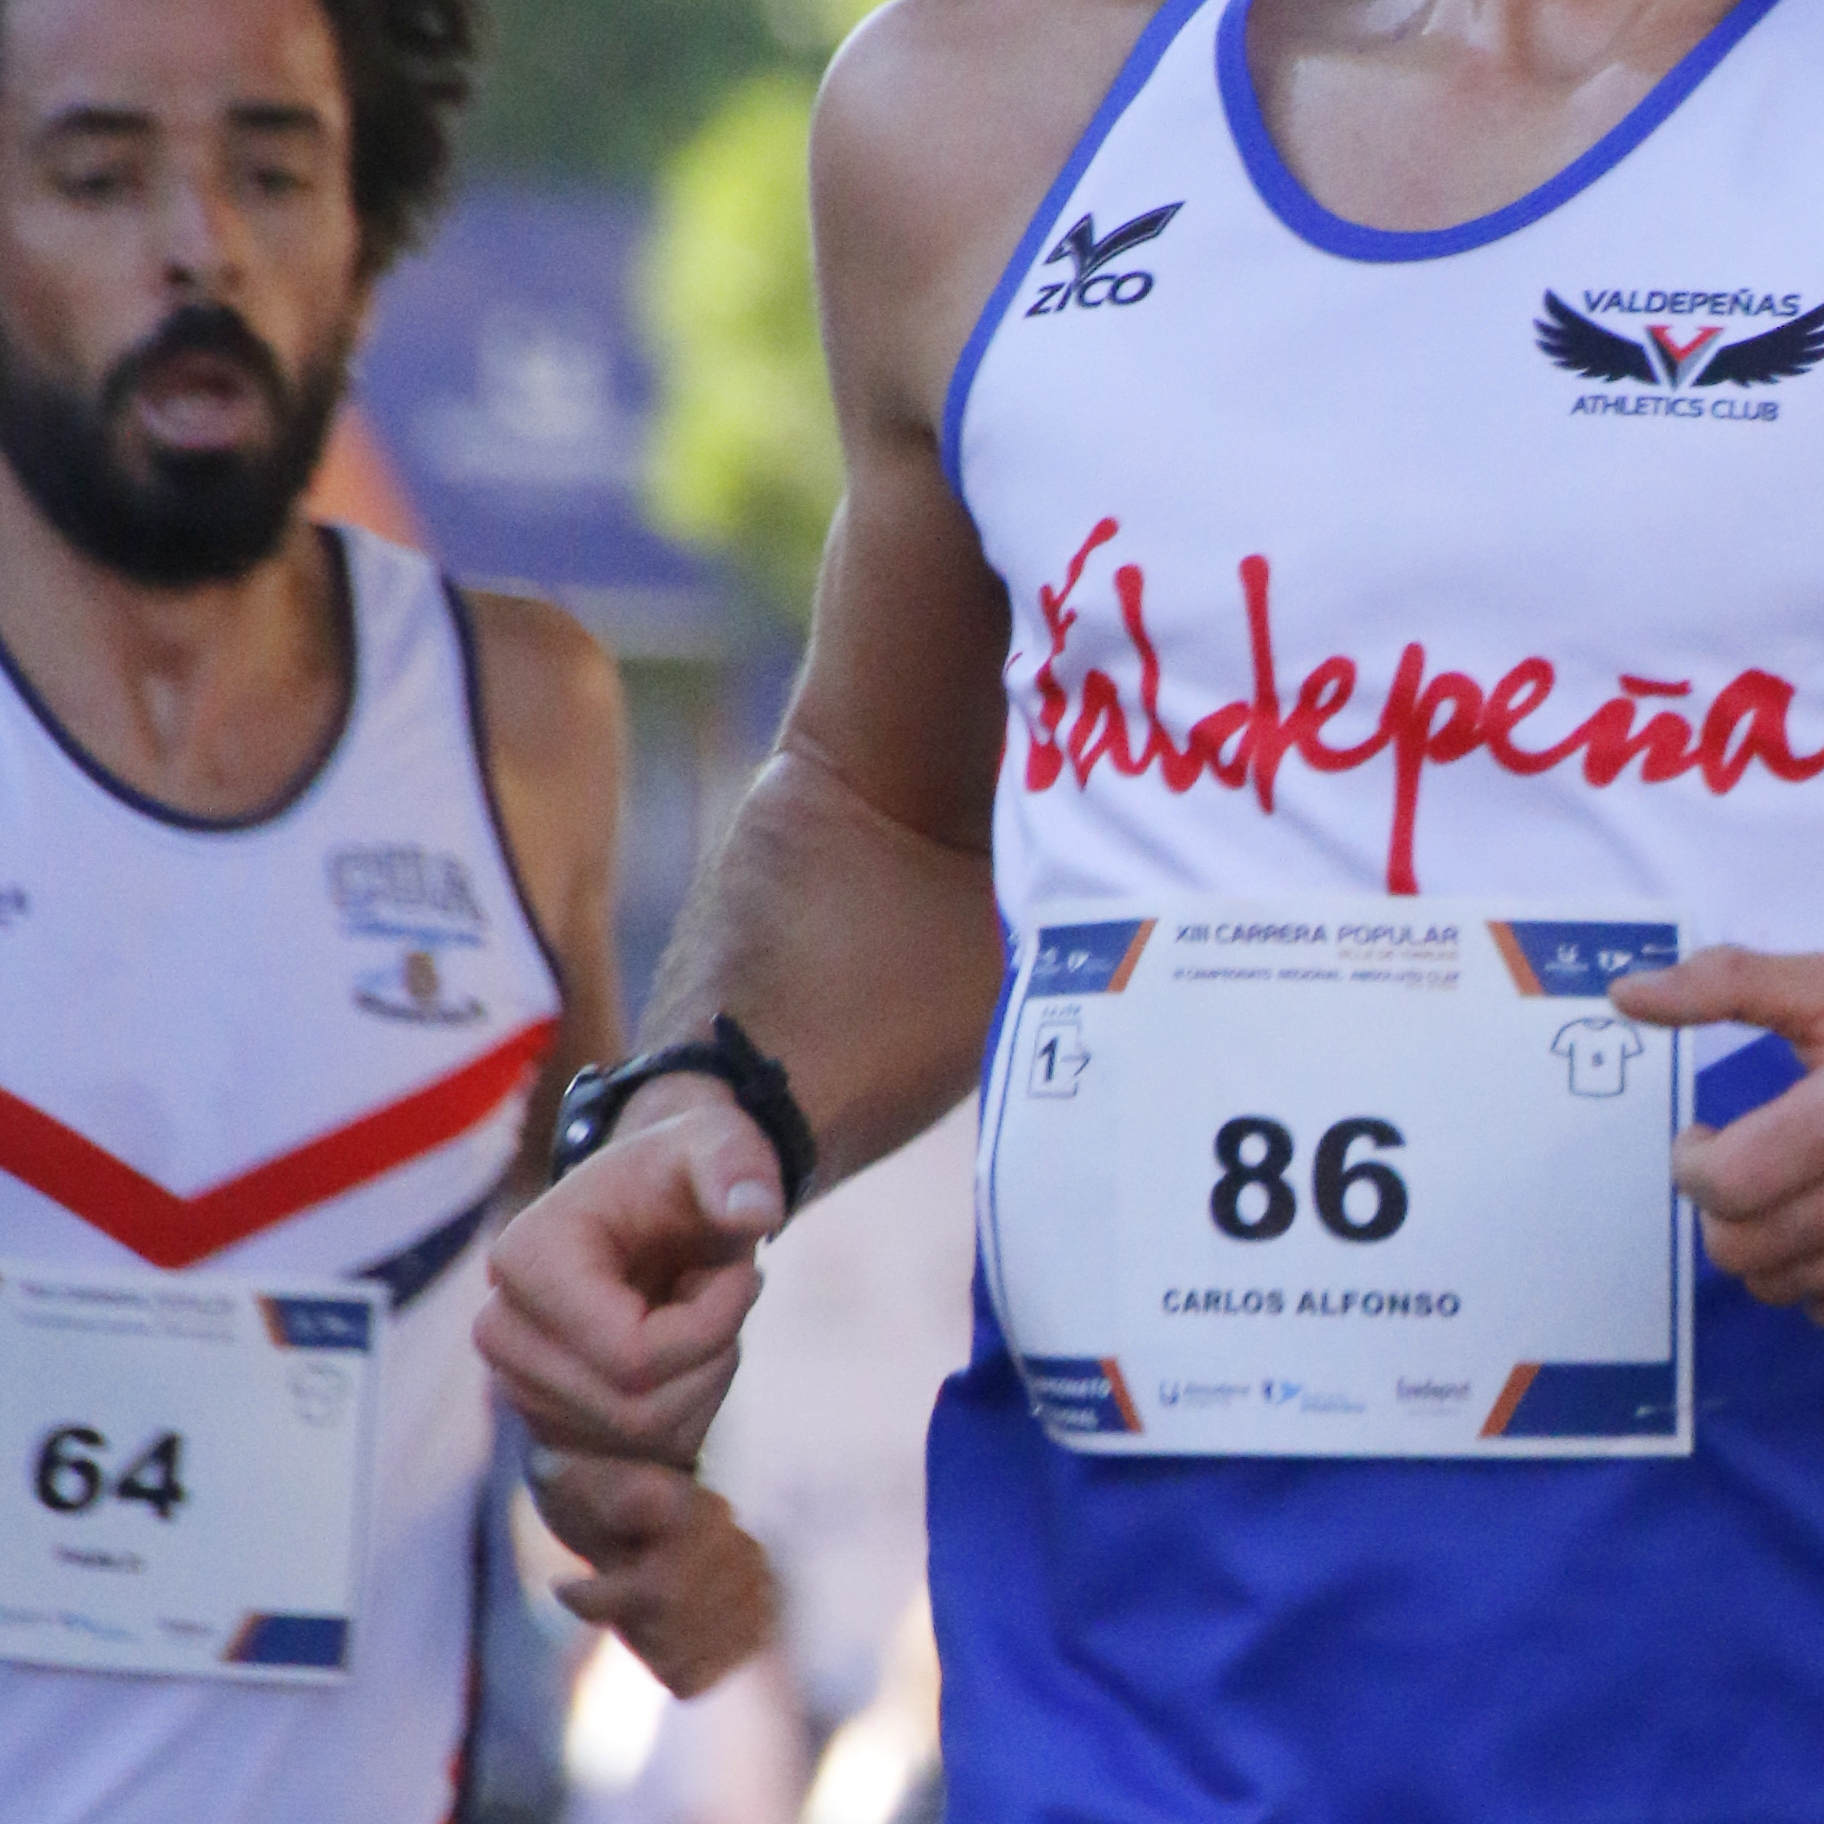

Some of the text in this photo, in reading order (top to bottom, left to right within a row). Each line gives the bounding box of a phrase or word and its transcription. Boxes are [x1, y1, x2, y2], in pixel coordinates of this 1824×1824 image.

[1024, 271, 1154, 318] ZICO
[1582, 287, 1801, 318] VALDEPEÑAS
[1570, 393, 1780, 422] ATHLETICS CLUB
[1214, 923, 1328, 944] CARRERA
[1336, 924, 1460, 946] POPULAR
[1208, 1114, 1411, 1244] 86
[1162, 1288, 1462, 1318] CARLOS ALFONSO
[33, 1423, 188, 1522] 64
